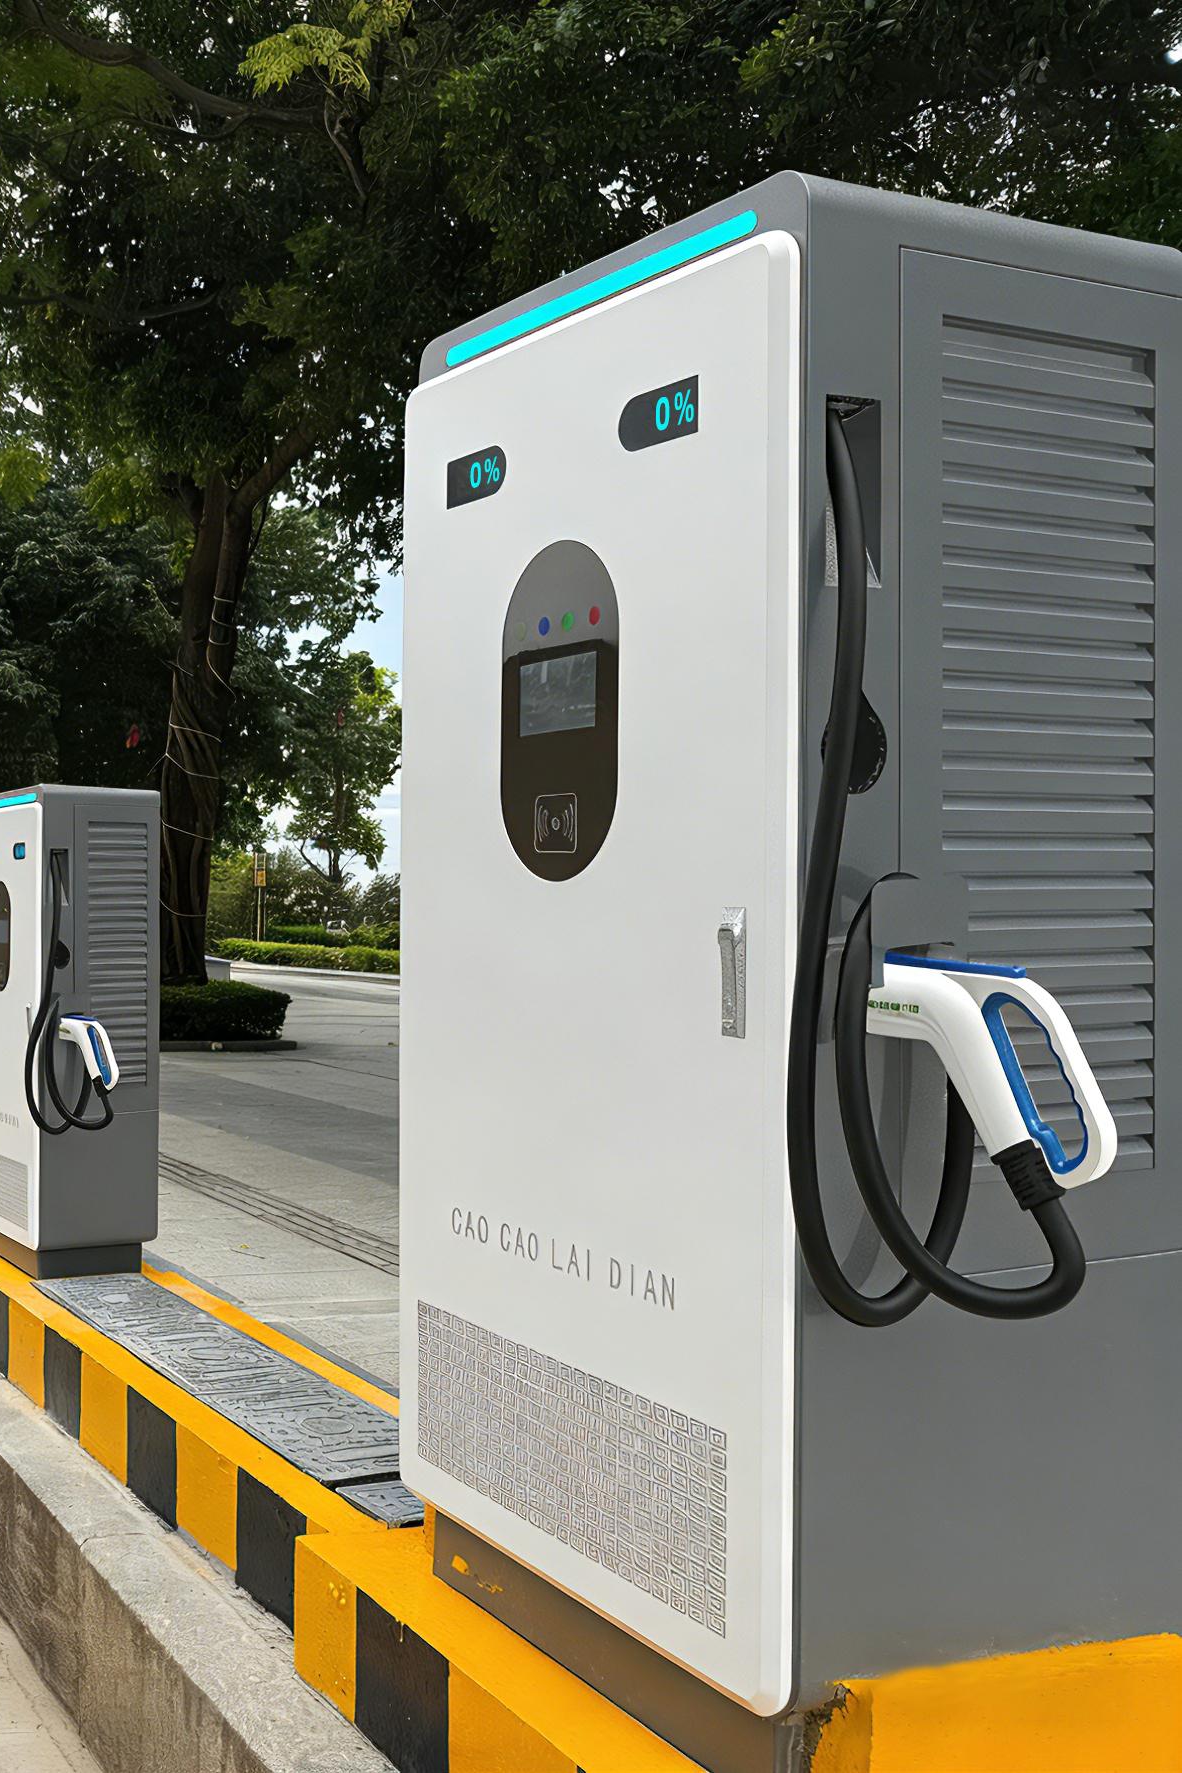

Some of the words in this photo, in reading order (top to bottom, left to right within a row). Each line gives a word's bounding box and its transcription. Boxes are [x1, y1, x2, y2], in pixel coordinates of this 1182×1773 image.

[654, 388, 695, 432] 0%
[469, 455, 501, 489] 0%
[451, 1207, 489, 1243] CAO
[500, 1222, 539, 1262] CAO
[551, 1238, 591, 1282] LAI
[609, 1256, 675, 1311] DIAN
